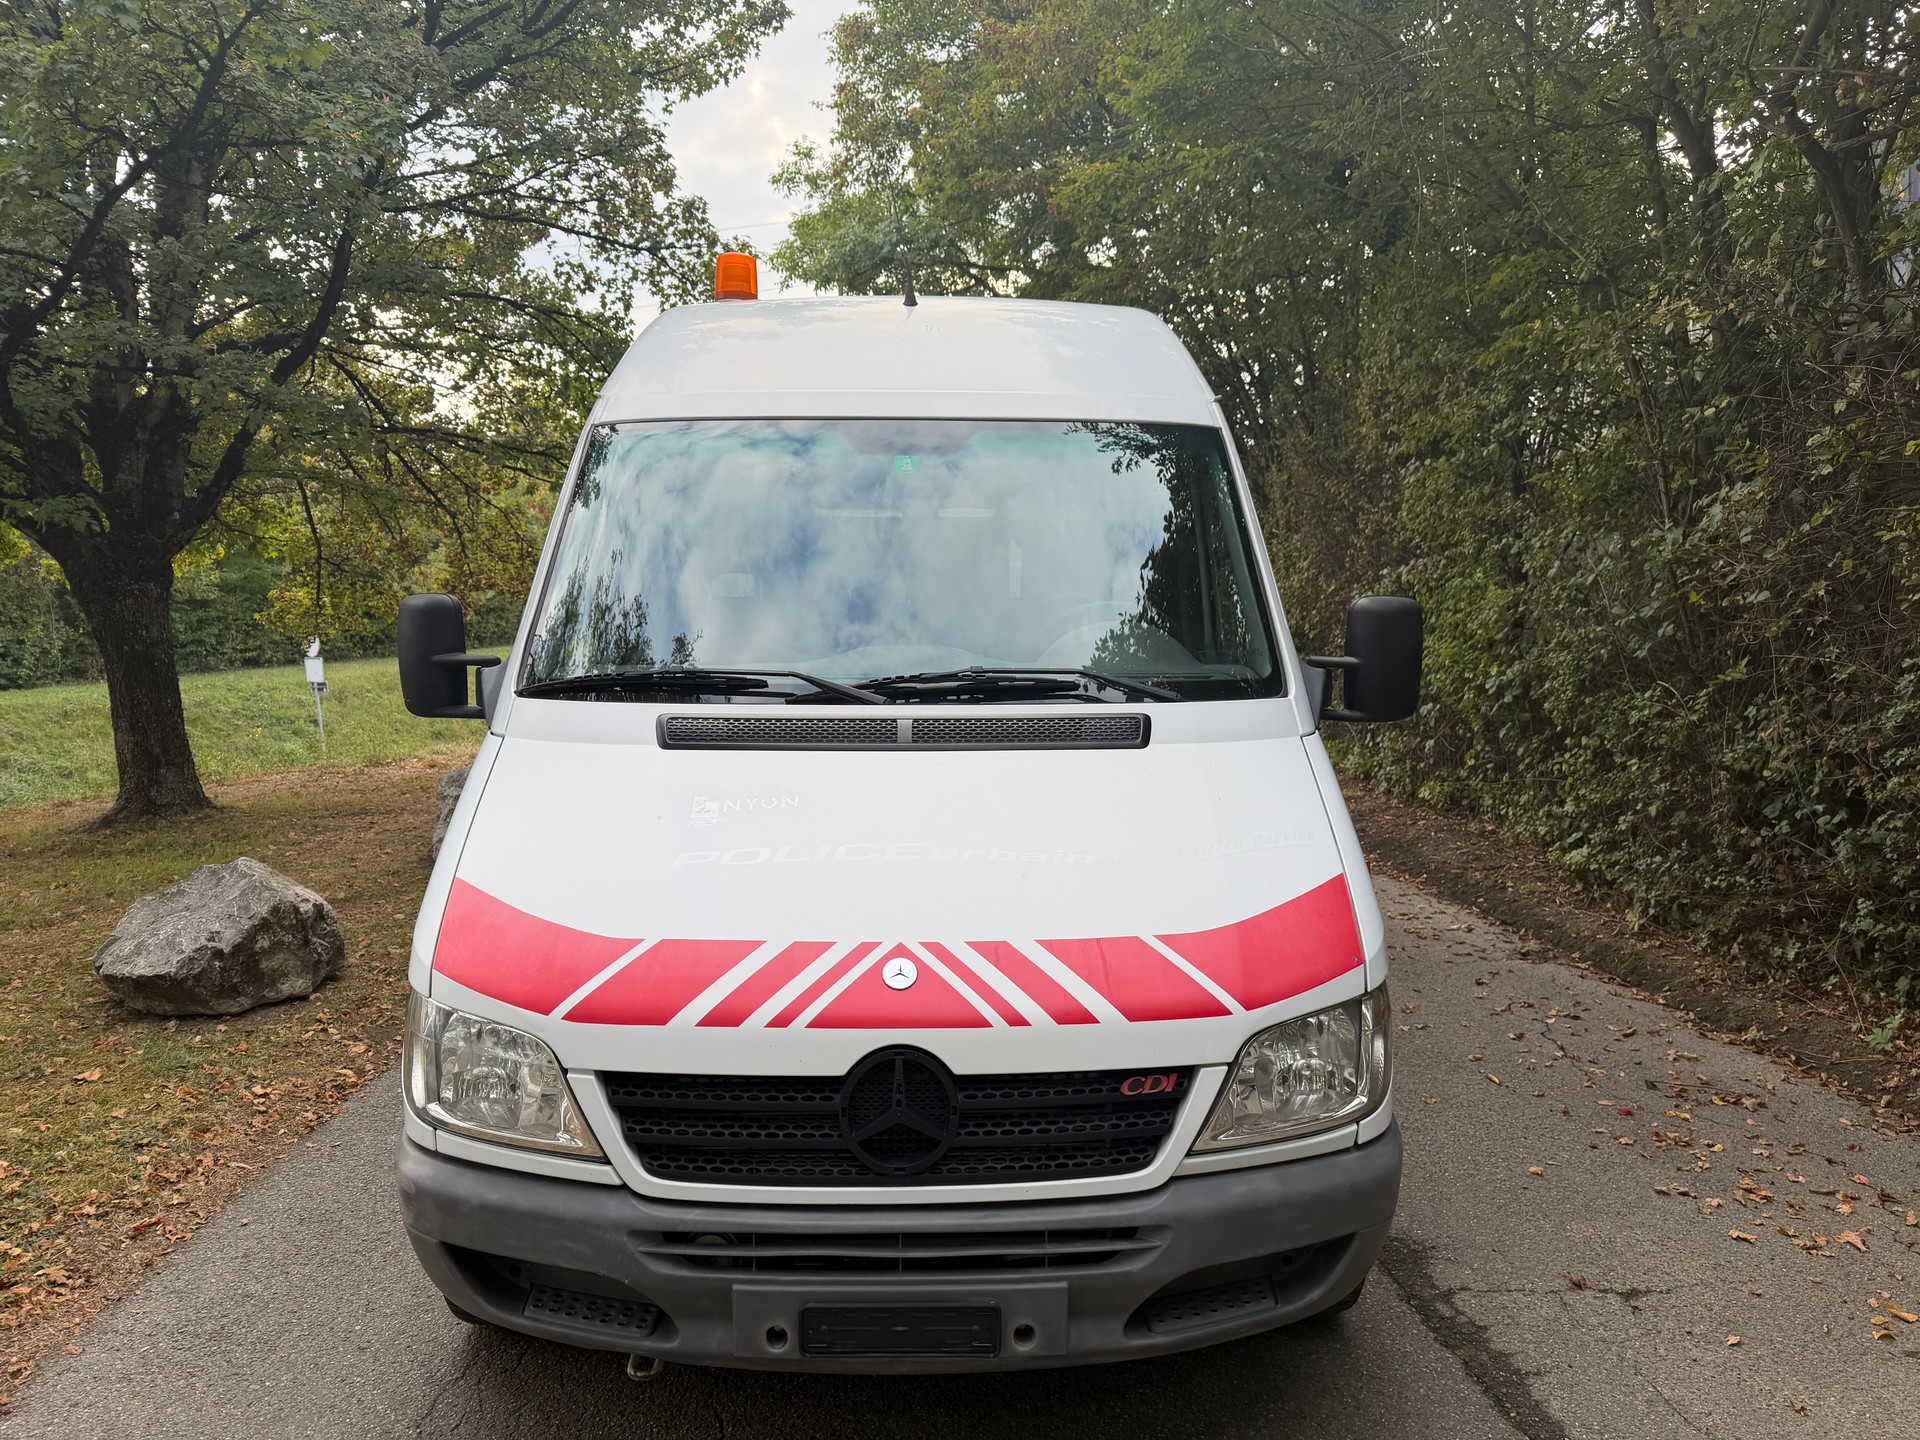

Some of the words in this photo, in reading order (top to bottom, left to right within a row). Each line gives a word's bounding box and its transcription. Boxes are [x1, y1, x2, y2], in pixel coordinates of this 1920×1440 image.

[722, 794, 799, 812] NYON
[670, 842, 927, 870] POLICE
[1120, 1073, 1178, 1096] CDI
